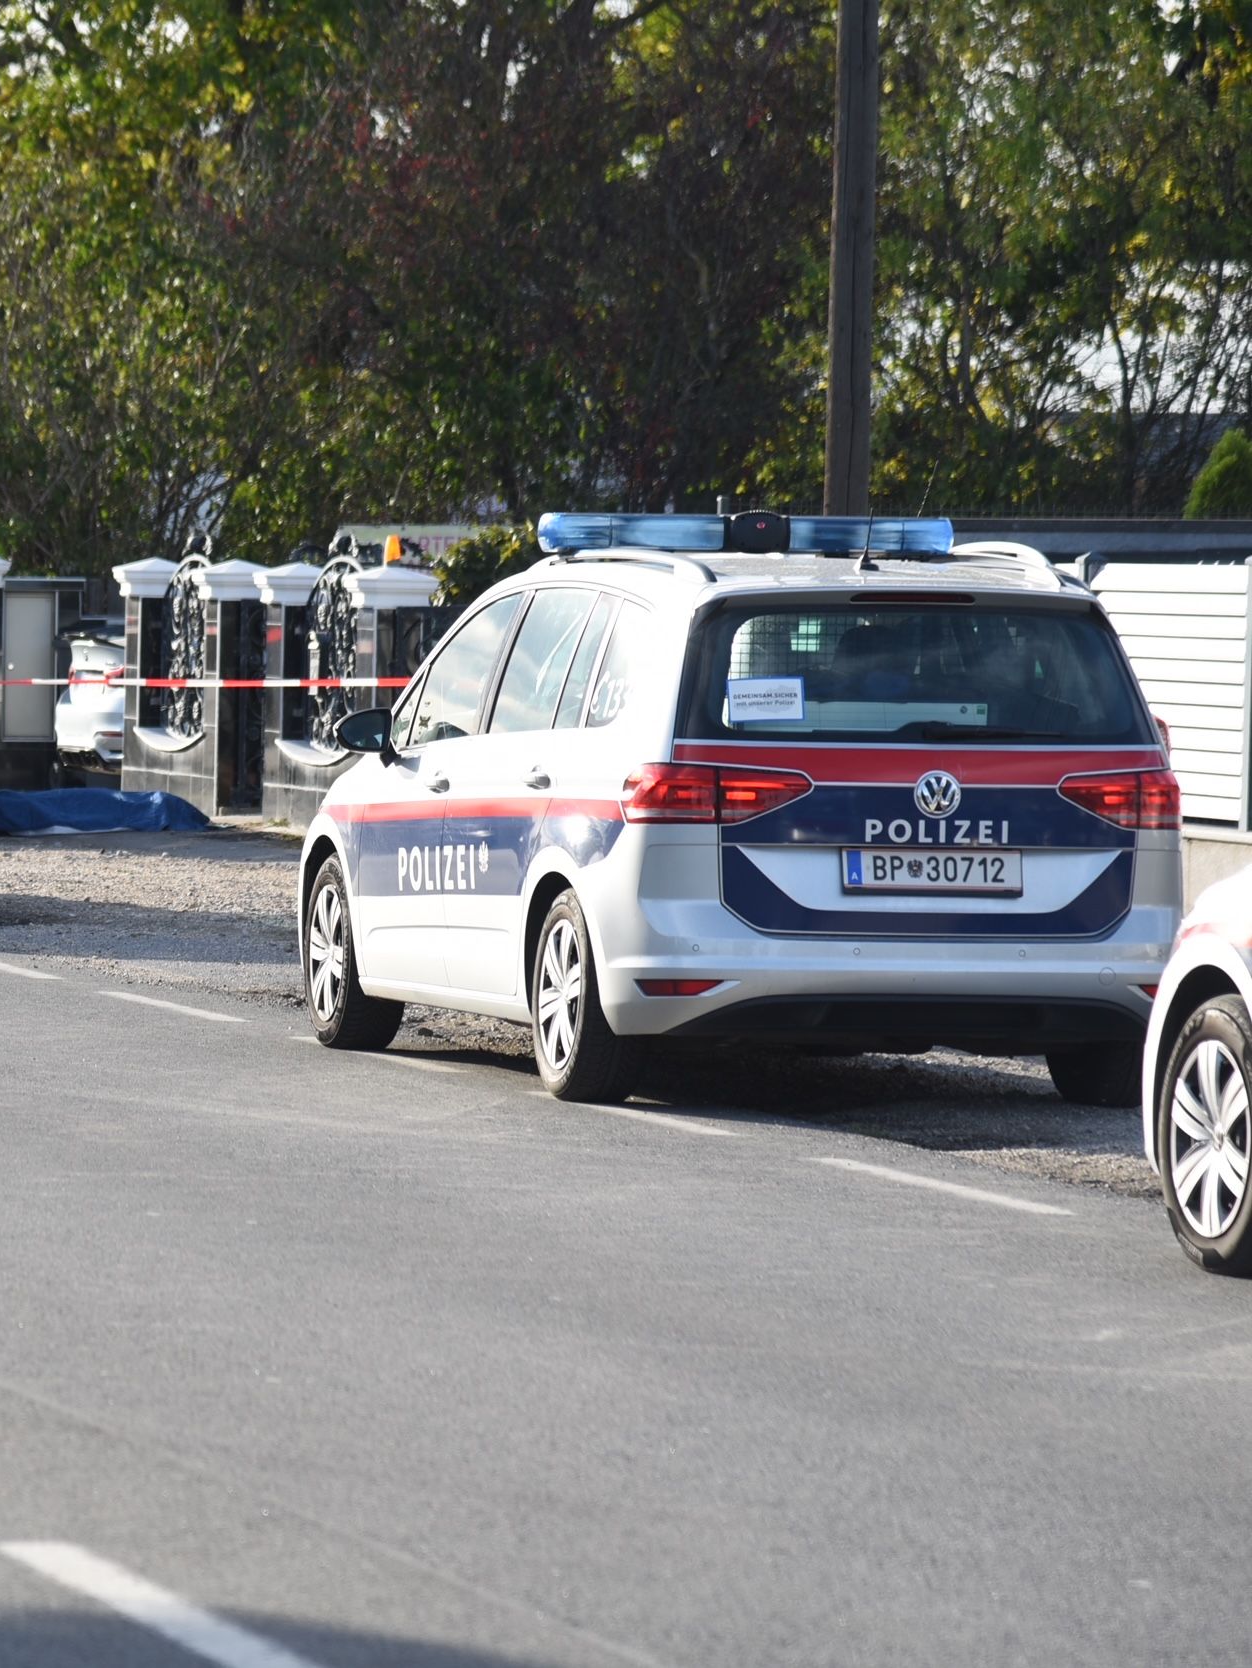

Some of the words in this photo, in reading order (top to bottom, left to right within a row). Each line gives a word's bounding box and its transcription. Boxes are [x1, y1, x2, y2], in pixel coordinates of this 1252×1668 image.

[864, 818, 1010, 845] POLIZEI
[398, 844, 476, 892] POLIZEI
[851, 871, 859, 880] A
[872, 855, 904, 882] BP
[926, 856, 1005, 883] 30712
